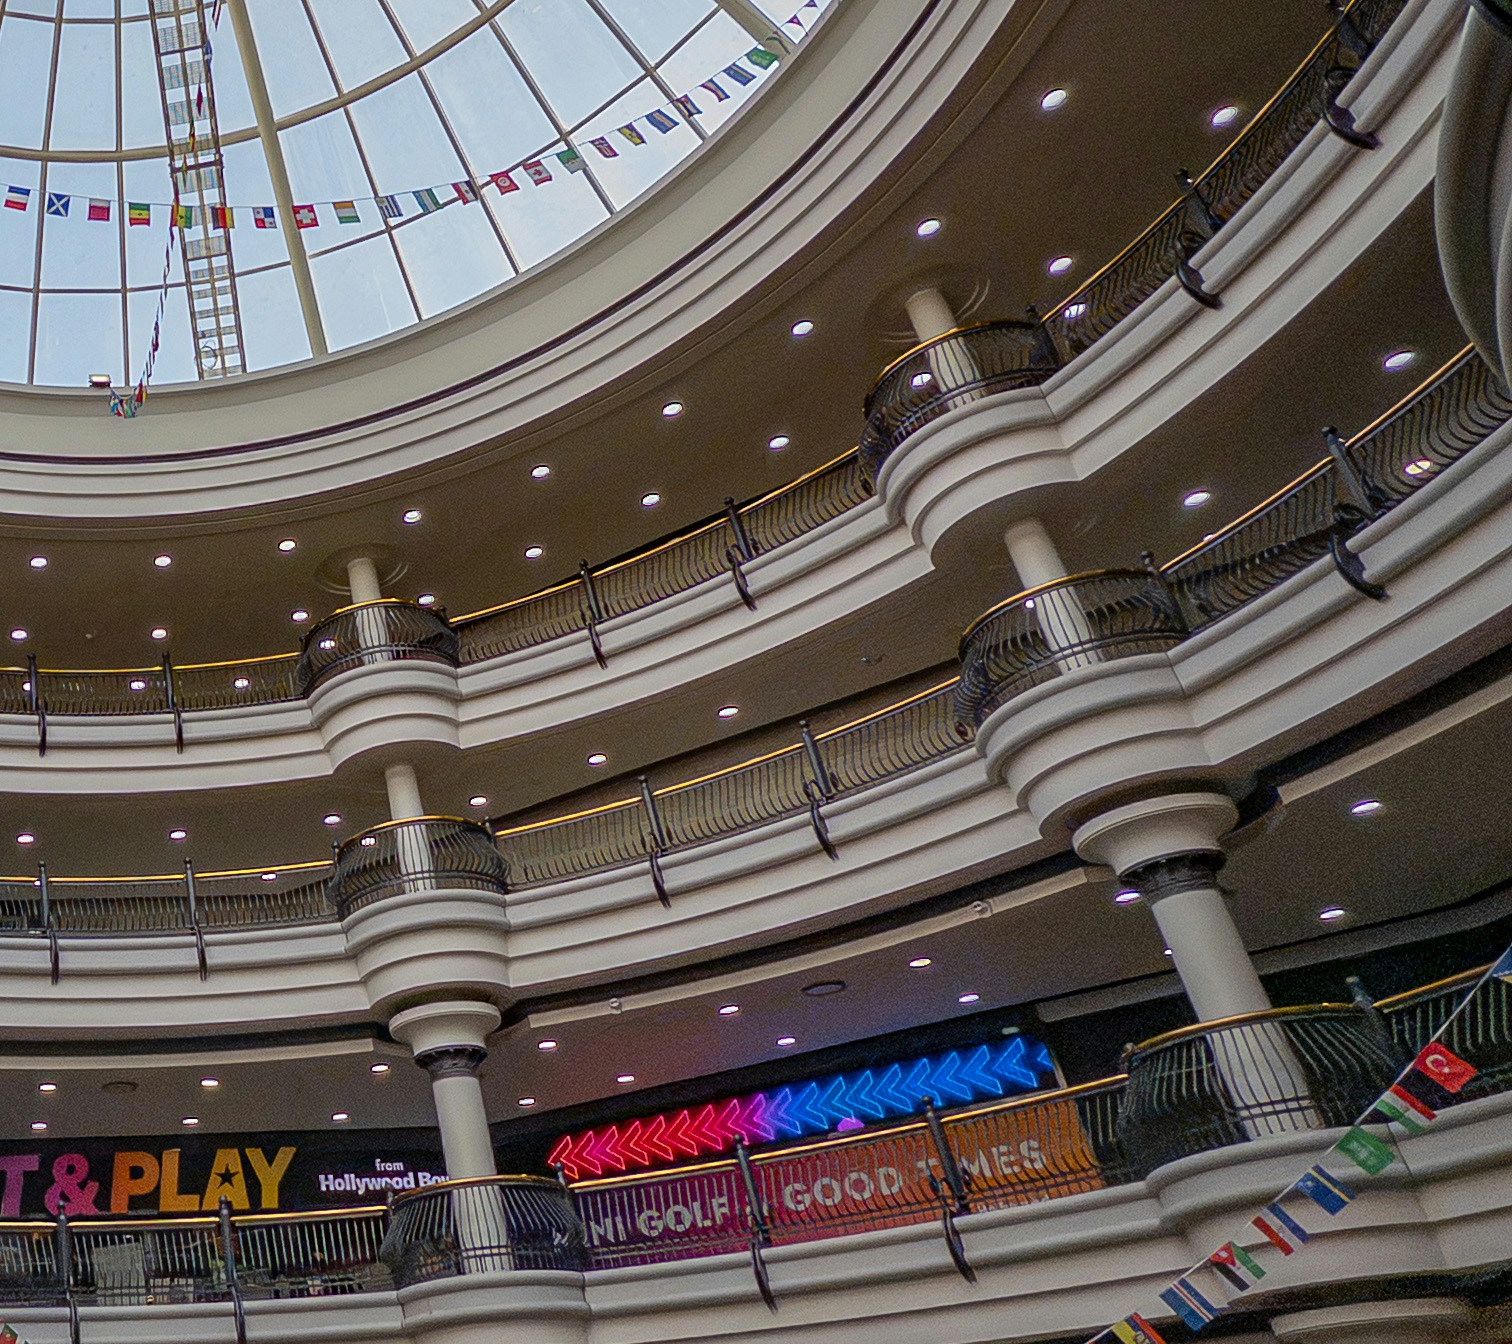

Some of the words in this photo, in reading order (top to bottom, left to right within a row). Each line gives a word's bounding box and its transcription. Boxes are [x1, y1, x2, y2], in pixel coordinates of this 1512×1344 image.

[44, 1153, 99, 1216] &
[110, 1146, 297, 1214] PLAY
[319, 1173, 415, 1195] Hollywood
[375, 1158, 404, 1172] from
[639, 1195, 731, 1238] GOLF
[783, 1166, 903, 1212] GOOD
[917, 1139, 1047, 1186] TMES
